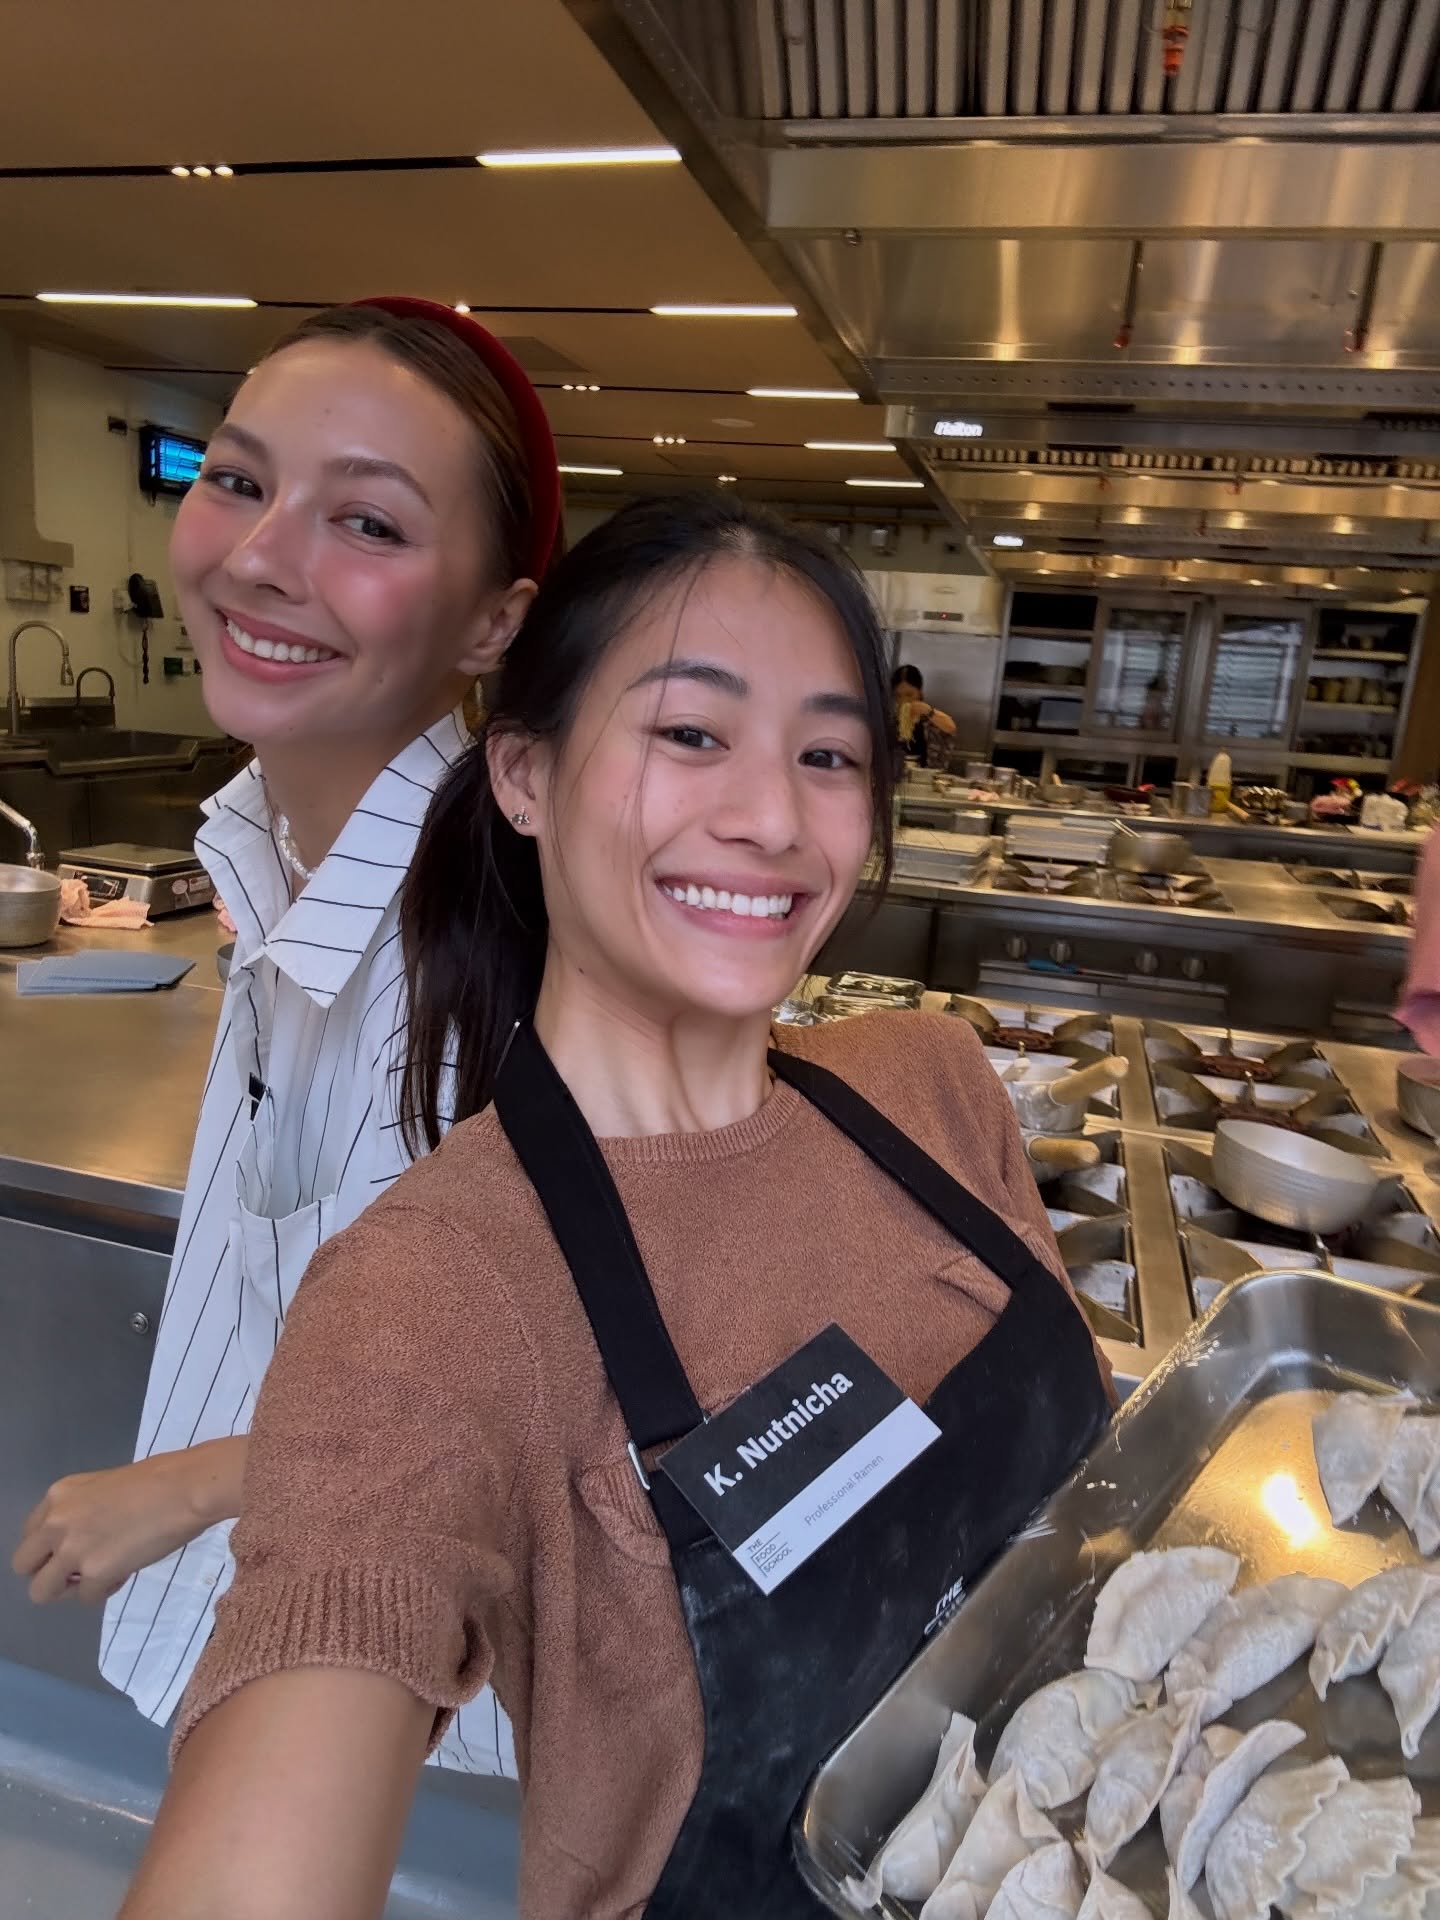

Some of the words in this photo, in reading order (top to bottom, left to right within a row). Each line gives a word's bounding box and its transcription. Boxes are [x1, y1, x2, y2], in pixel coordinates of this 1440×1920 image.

[704, 1462, 743, 1497] K.
[736, 1371, 853, 1470] Nutnicha
[804, 1477, 856, 1526] Professional
[853, 1455, 885, 1483] Ramen
[747, 1538, 763, 1553] THE
[755, 1543, 776, 1563] FOOD
[763, 1547, 792, 1573] SCHOOL
